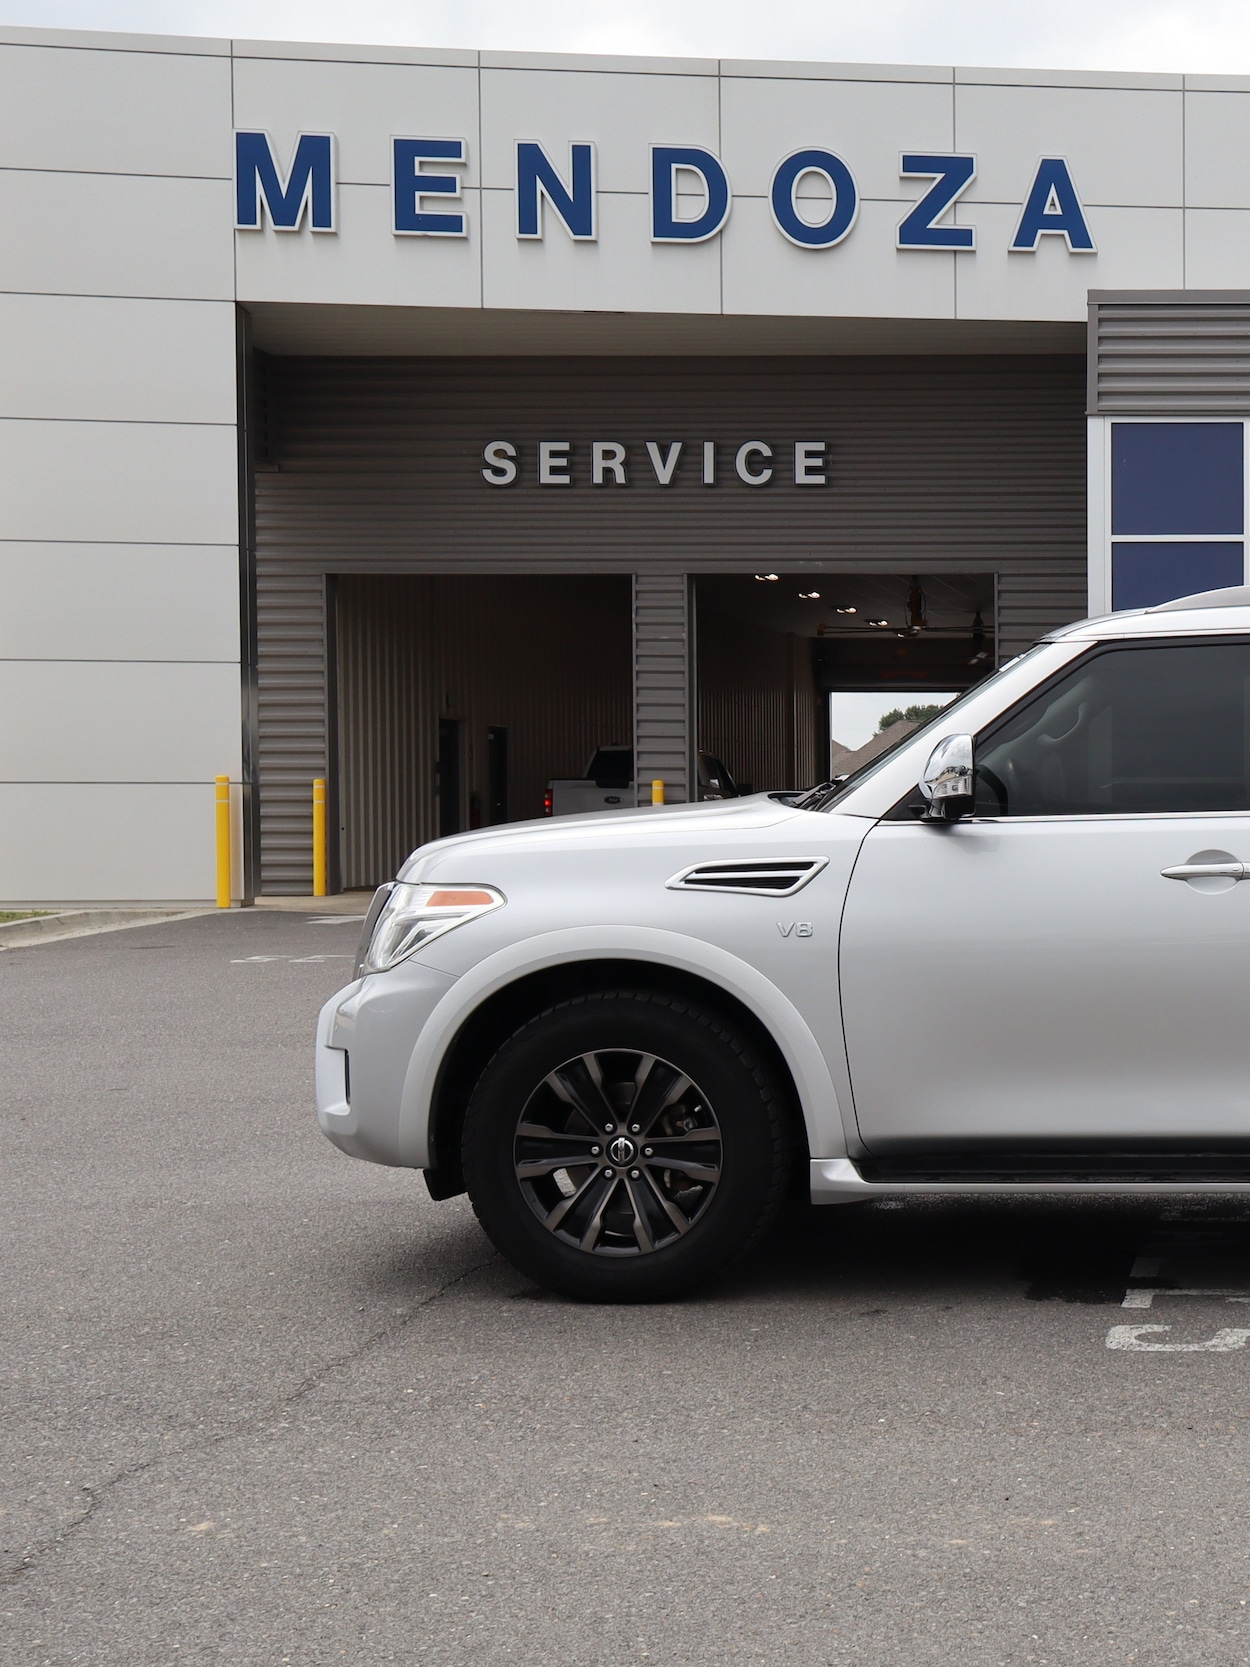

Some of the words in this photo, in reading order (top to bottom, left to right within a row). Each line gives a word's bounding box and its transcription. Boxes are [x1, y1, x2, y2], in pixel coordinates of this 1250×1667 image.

[234, 128, 1098, 253] MENDOZA
[481, 439, 829, 487] SERVICE
[776, 921, 813, 938] V8
